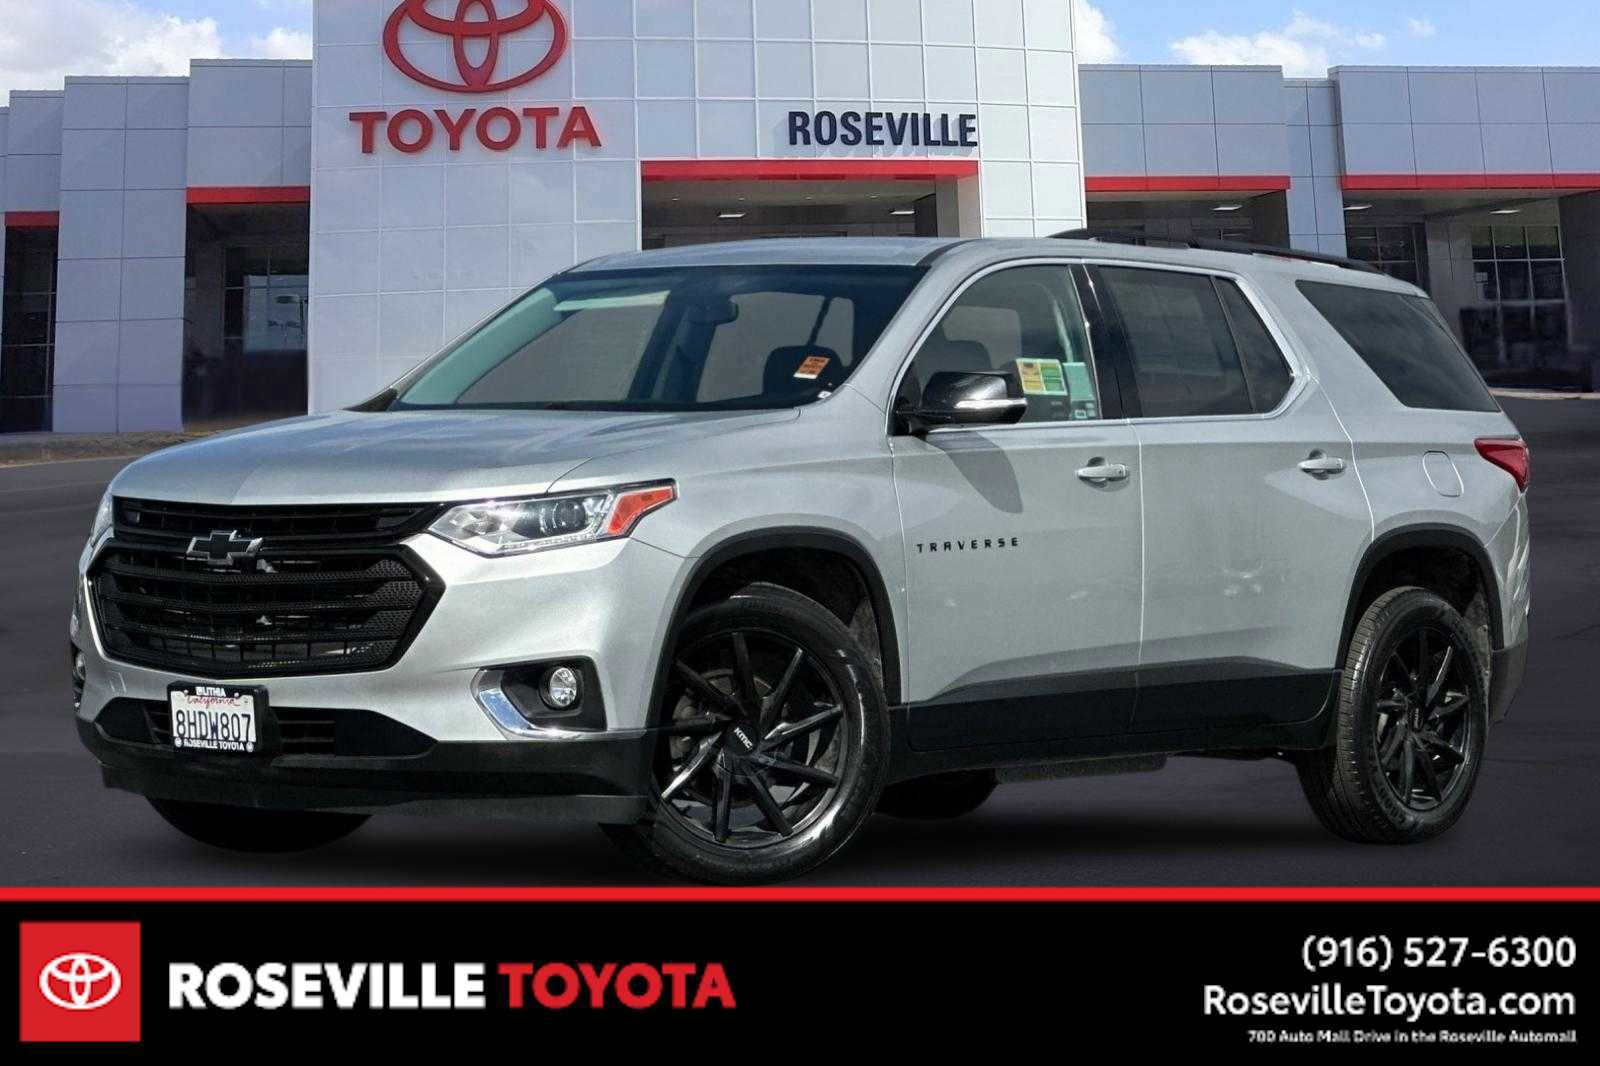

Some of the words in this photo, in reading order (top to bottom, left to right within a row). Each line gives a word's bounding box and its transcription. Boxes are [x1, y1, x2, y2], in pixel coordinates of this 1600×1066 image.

[349, 106, 602, 154] TOYOTA
[788, 110, 978, 147] ROSEVILLE
[916, 537, 1019, 553] TRAVERSE
[176, 709, 251, 742] 8HDW807
[183, 738, 218, 749] ROSEVILLE
[219, 741, 245, 751] TOYOTA
